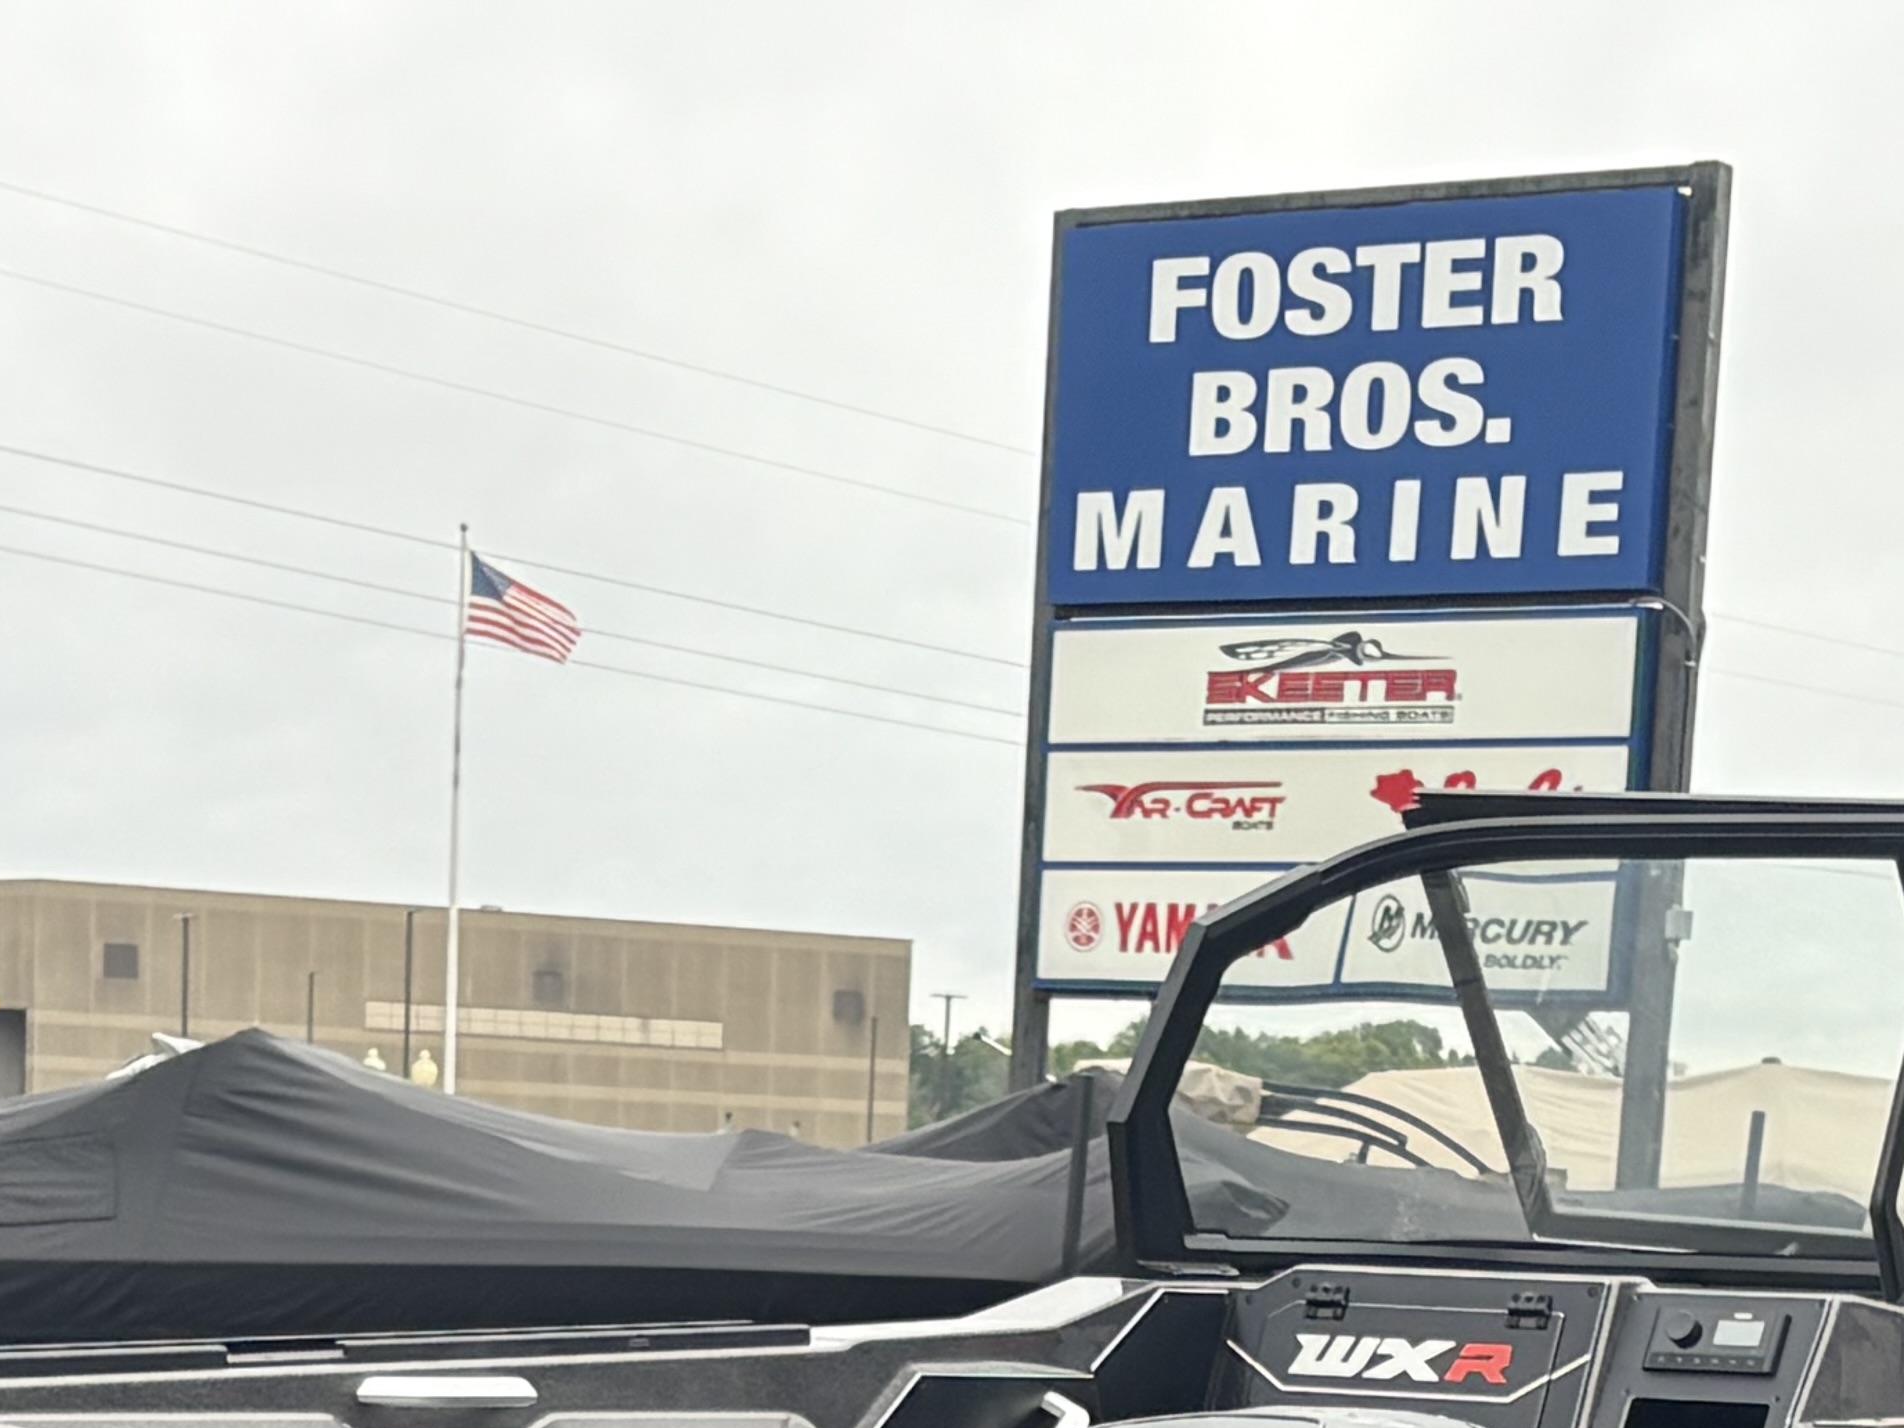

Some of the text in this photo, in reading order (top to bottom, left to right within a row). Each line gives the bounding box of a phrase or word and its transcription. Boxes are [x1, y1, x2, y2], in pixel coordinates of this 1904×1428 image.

[1149, 234, 1564, 343] FOSTER
[1188, 357, 1511, 457] BROS.
[1073, 471, 1624, 572] MARINE
[1206, 669, 1458, 704] SKEETER
[1206, 708, 1449, 724] PERFORMANCE FISHING BOATS
[1114, 901, 1294, 960] YAM
[1410, 912, 1587, 945] MRCURY
[1288, 1334, 1513, 1384] WXR
